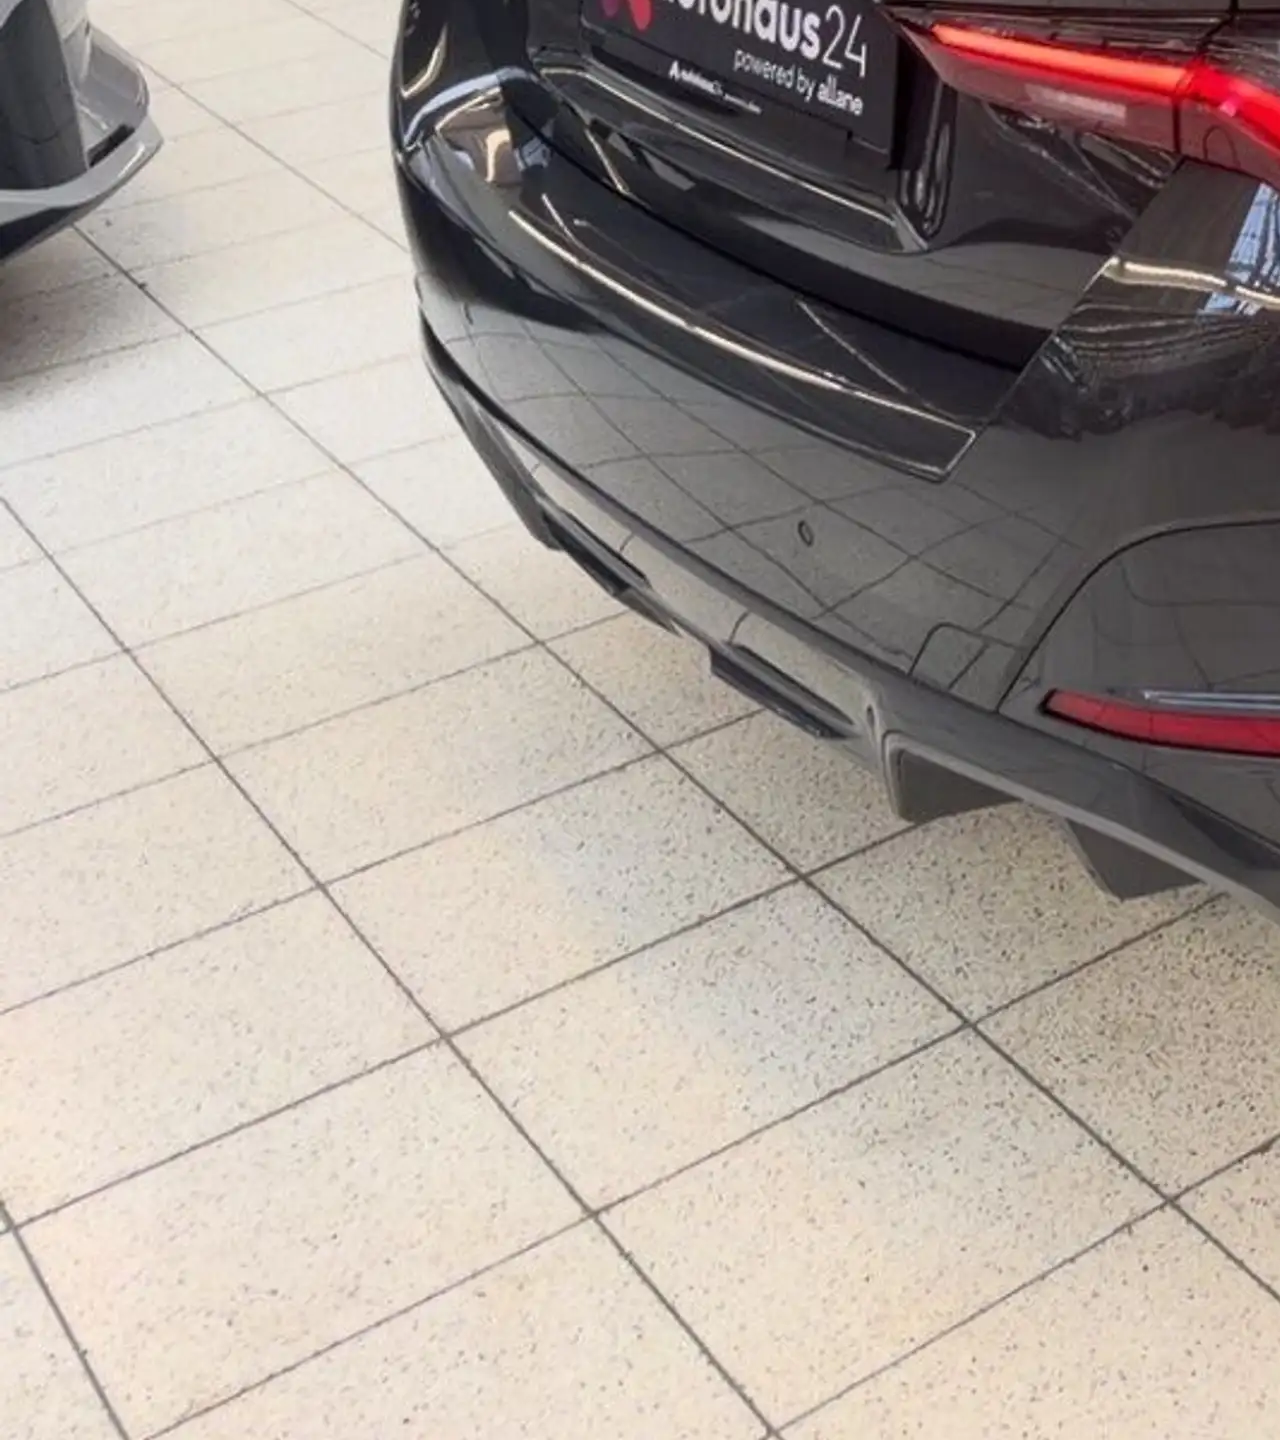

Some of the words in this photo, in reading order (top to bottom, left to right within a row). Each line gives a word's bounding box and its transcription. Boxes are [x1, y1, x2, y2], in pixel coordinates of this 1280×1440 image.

[733, 49, 793, 90] powered
[796, 67, 820, 103] by
[817, 73, 864, 115] allane
